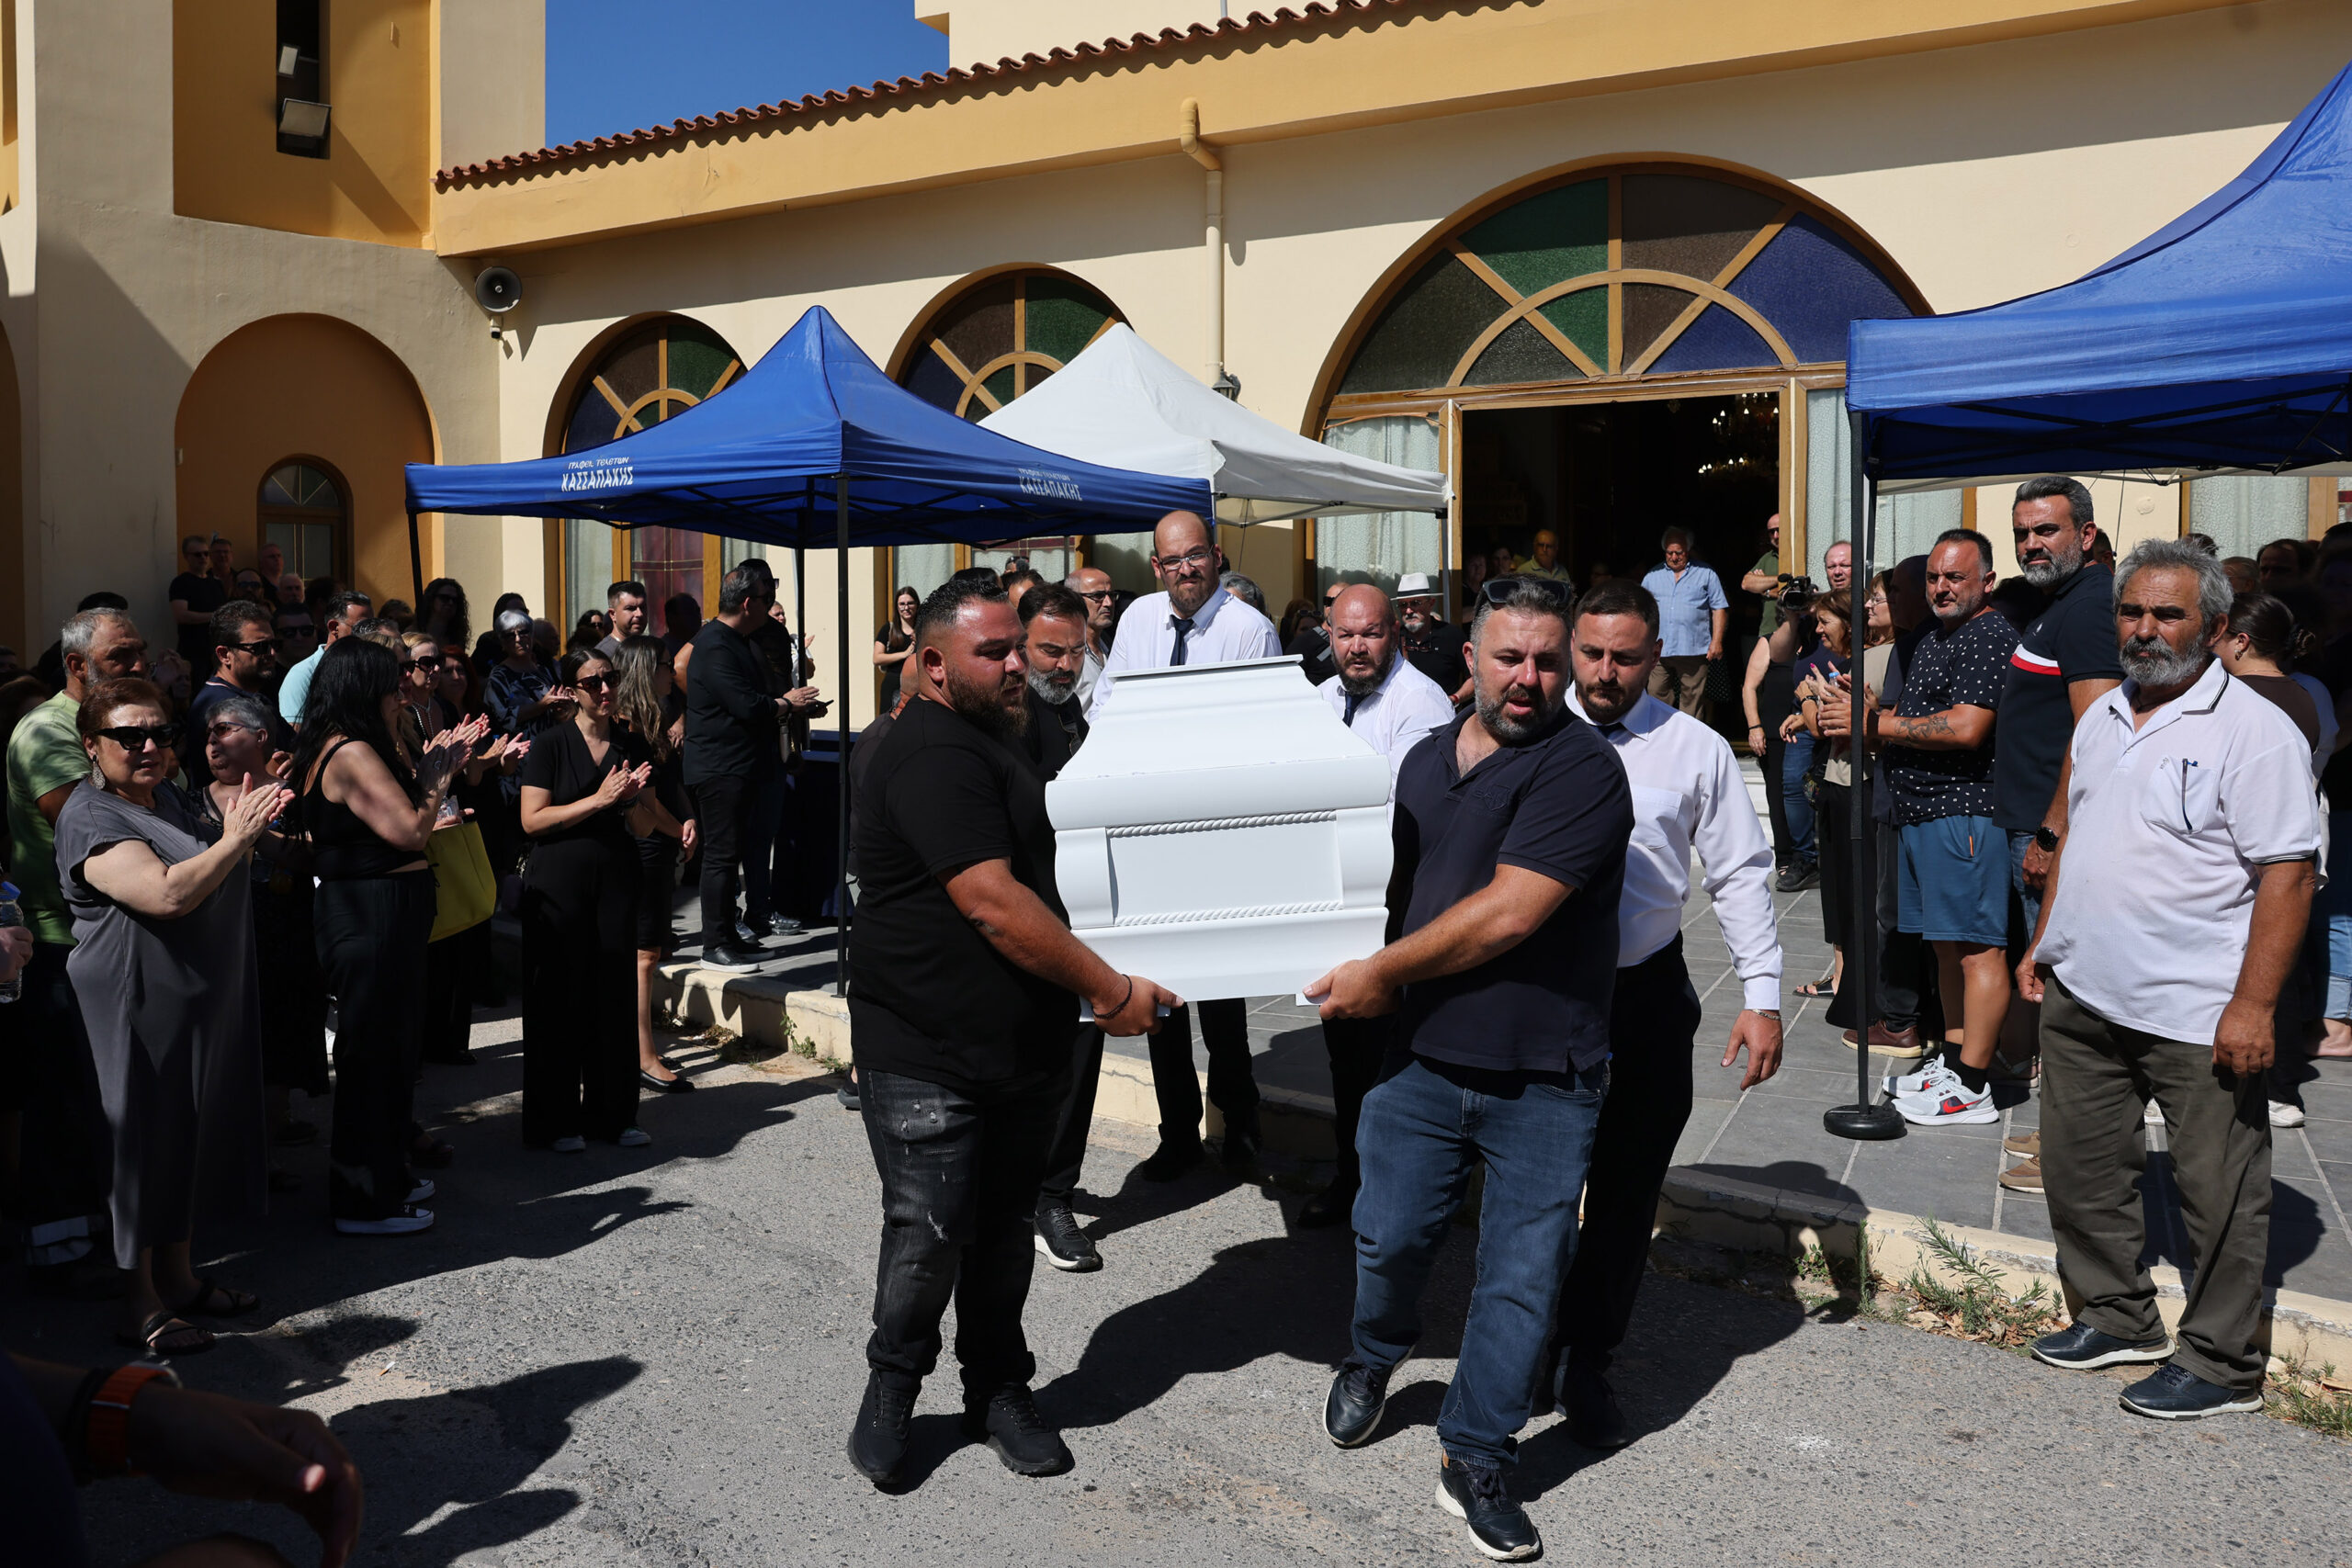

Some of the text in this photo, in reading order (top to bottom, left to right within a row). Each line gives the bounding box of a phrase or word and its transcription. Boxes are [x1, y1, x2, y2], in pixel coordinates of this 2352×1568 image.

[596, 457, 629, 467] ΤΕΛΕΤΩΝ
[560, 467, 634, 492] ΚΑΣΣΑΠΑΚΗΣ
[1019, 476, 1083, 502] ΚΑΣΣΑΠΑΚΗΣ
